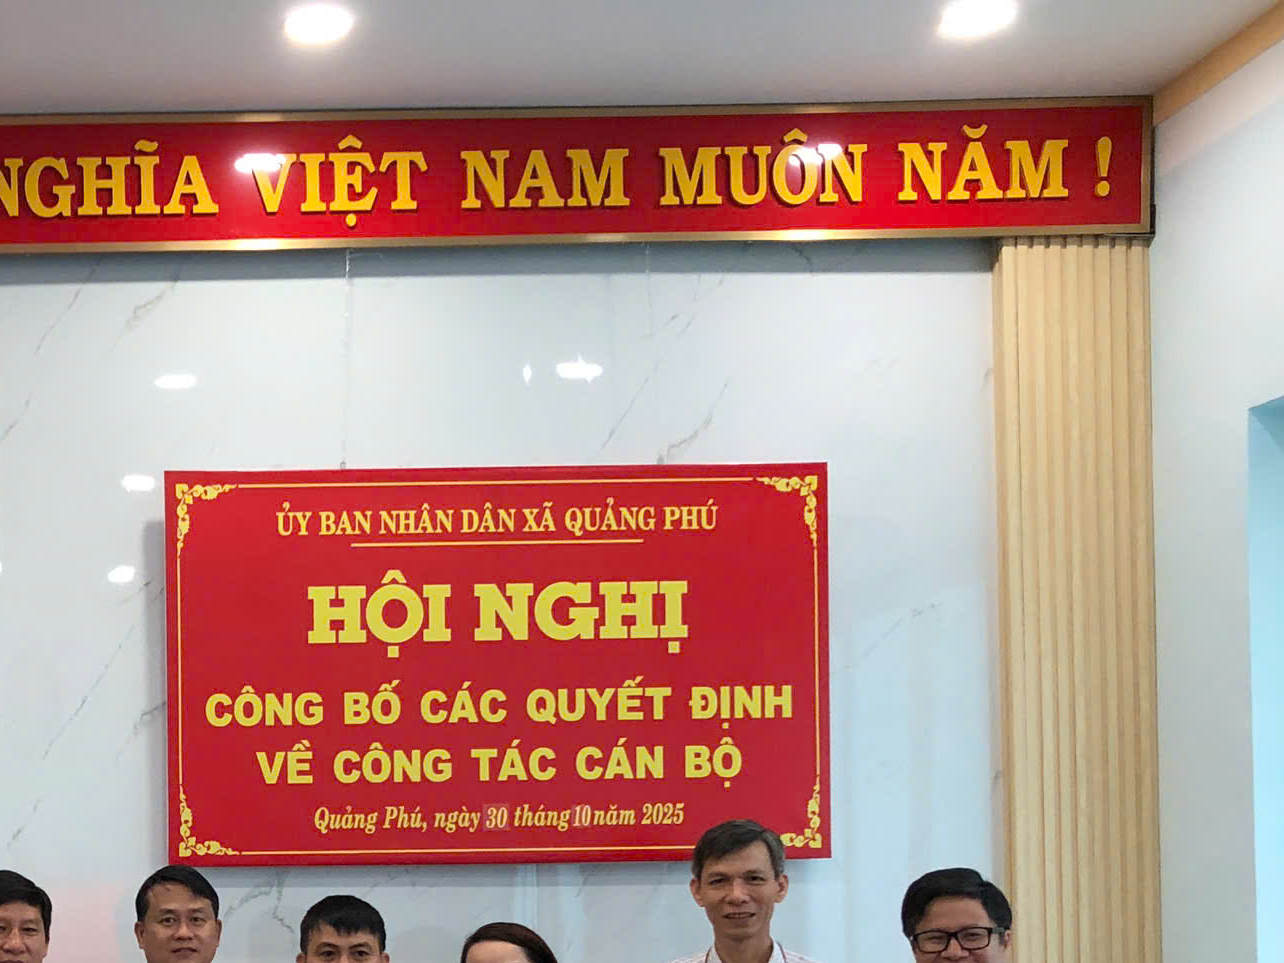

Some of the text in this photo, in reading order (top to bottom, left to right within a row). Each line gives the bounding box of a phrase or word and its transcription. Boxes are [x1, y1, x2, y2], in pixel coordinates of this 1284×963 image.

[242, 134, 428, 227] VIỆT
[460, 149, 631, 208] NAM
[659, 127, 868, 206] MUÔN
[897, 124, 1069, 201] NĂM
[1095, 136, 1113, 198] !
[276, 498, 719, 537] ỦY BAN NHÂN DÂN XÃ QUẢNG PHÚ
[307, 569, 689, 659] HỘI NGHỊ
[205, 675, 793, 730] CÔNG BỐ CÁC QUYẾT ĐỊNH
[255, 736, 743, 788] VỀ CÔNG TÁC CÁN BỘ
[313, 802, 686, 835] Quảng Phú, ngày 30 tháng 10 năm 2025
